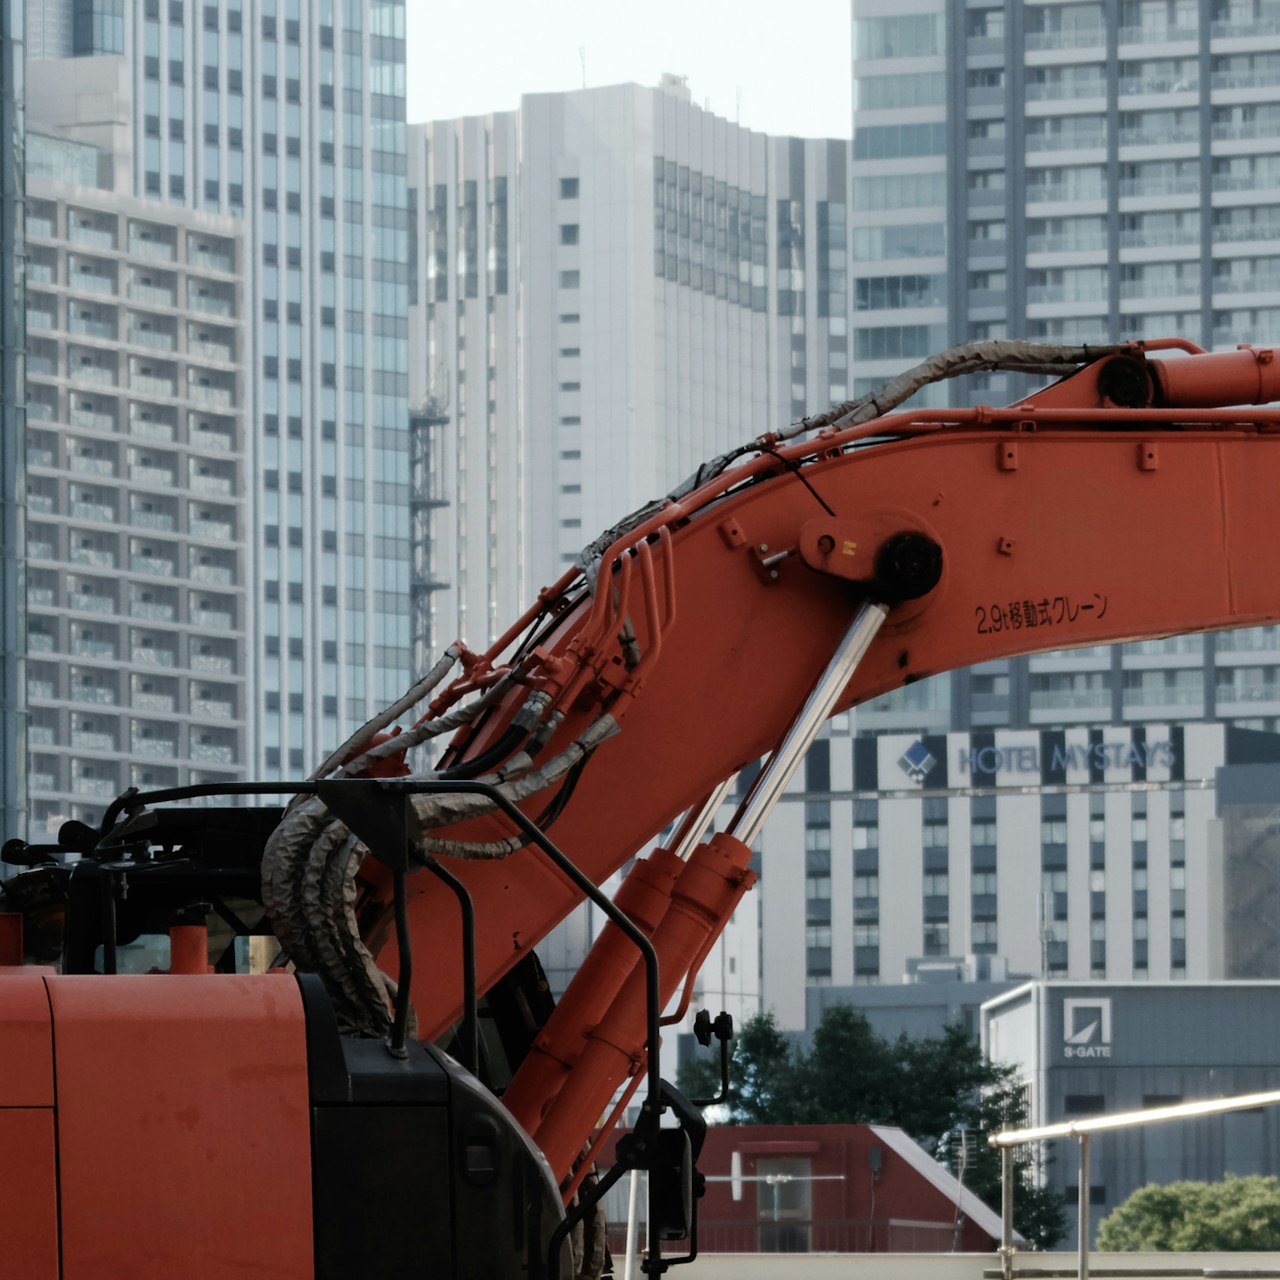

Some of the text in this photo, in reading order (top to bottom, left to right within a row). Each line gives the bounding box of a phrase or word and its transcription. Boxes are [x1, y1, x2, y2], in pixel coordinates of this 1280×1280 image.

[975, 593, 1108, 634] 2.9t移動式クレーン
[959, 741, 1176, 775] HOTEL MYSTAYS
